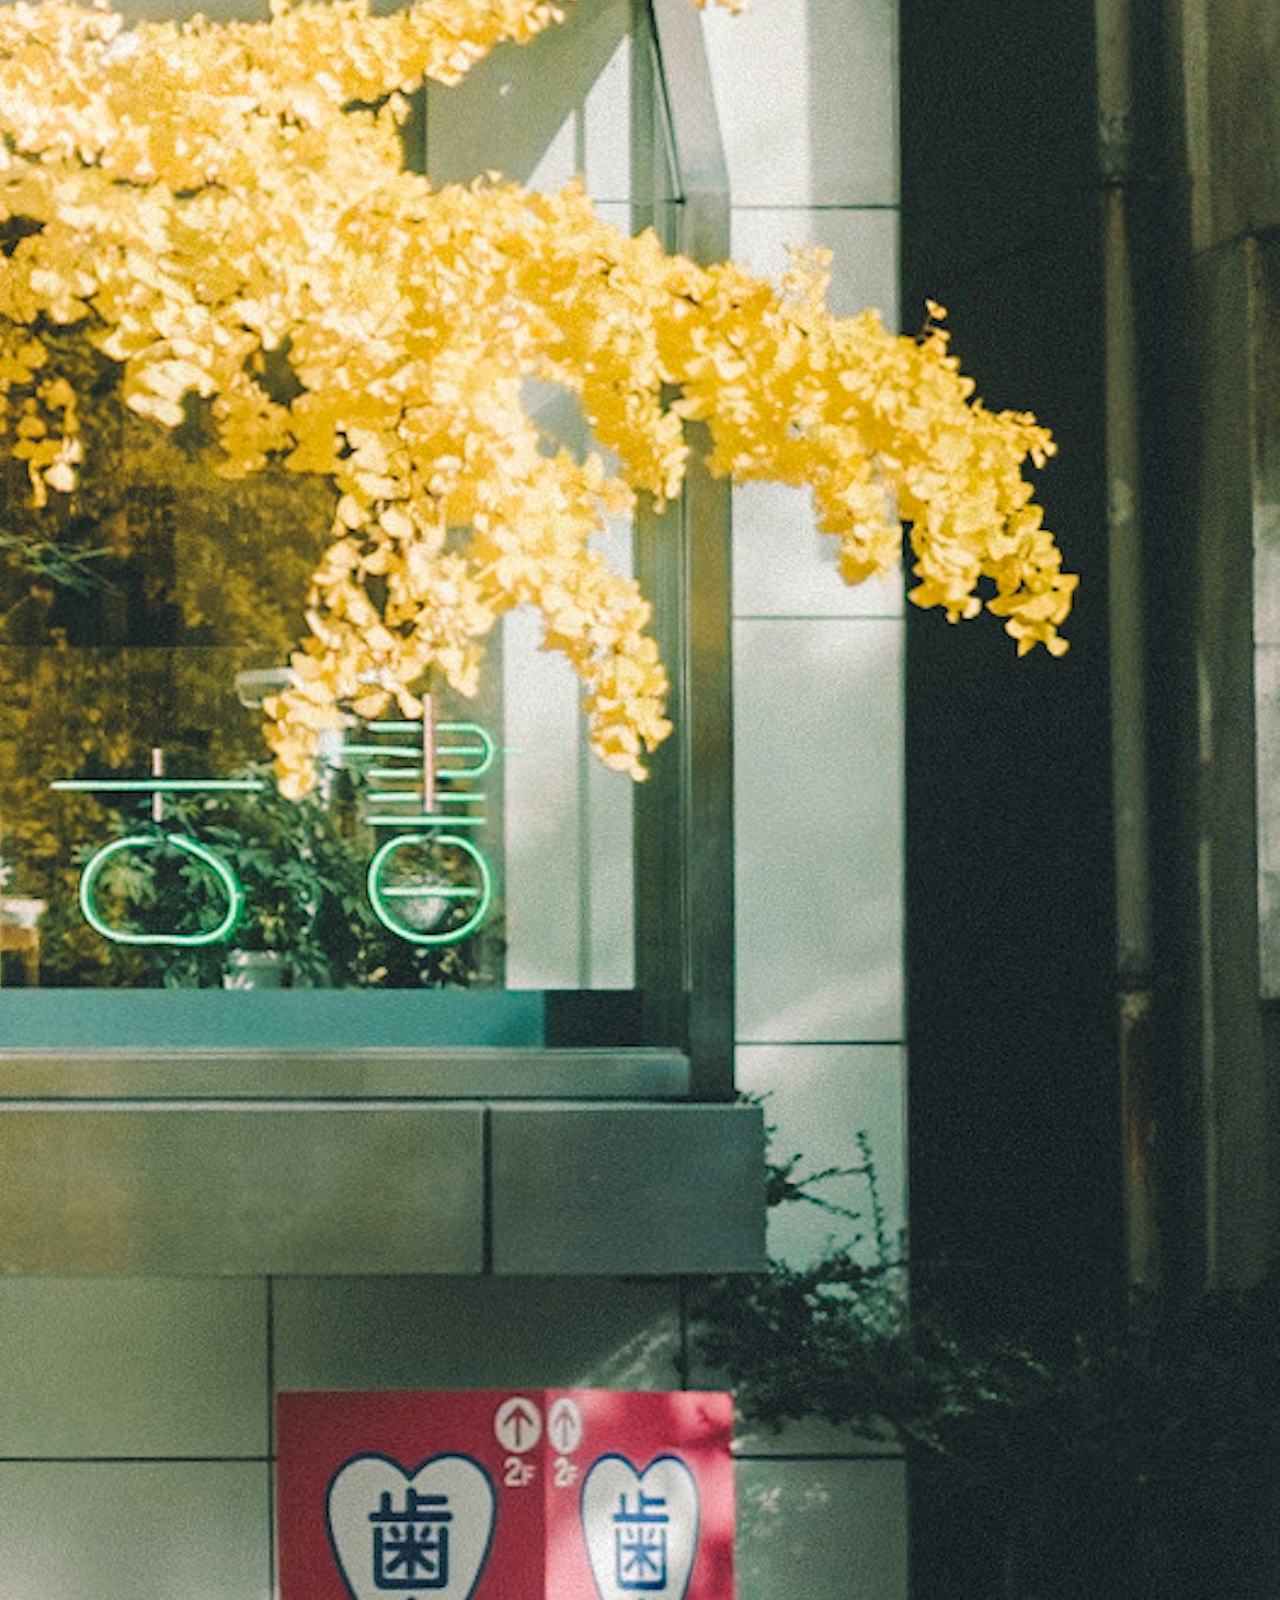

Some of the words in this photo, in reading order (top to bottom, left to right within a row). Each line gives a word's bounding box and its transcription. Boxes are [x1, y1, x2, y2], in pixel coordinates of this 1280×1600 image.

[504, 1456, 536, 1487] 2F
[553, 1456, 579, 1487] 2F
[368, 1487, 454, 1591] 歯
[612, 1489, 670, 1591] 歯
